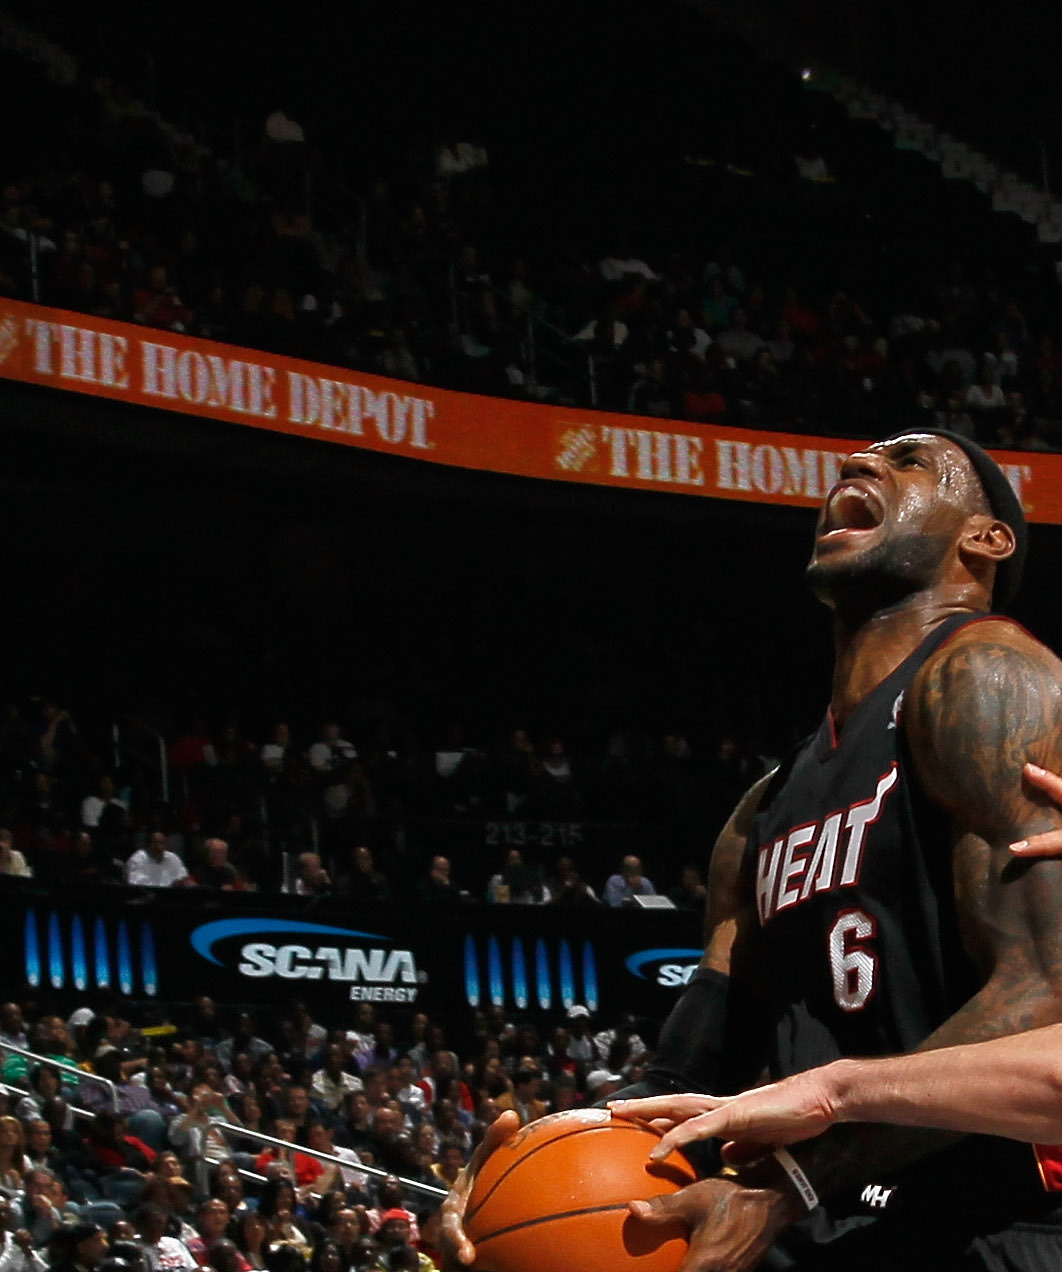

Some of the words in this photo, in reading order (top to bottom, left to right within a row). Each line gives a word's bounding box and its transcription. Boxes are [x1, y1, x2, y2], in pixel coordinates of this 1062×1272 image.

[26, 317, 130, 390] THE
[140, 340, 276, 420] HOME
[288, 373, 435, 449] DEPOT
[601, 426, 705, 486] THE
[755, 761, 898, 927] HEAT
[238, 943, 417, 983] SCANA
[349, 985, 418, 1003] ENERGY
[828, 907, 879, 1012] 6
